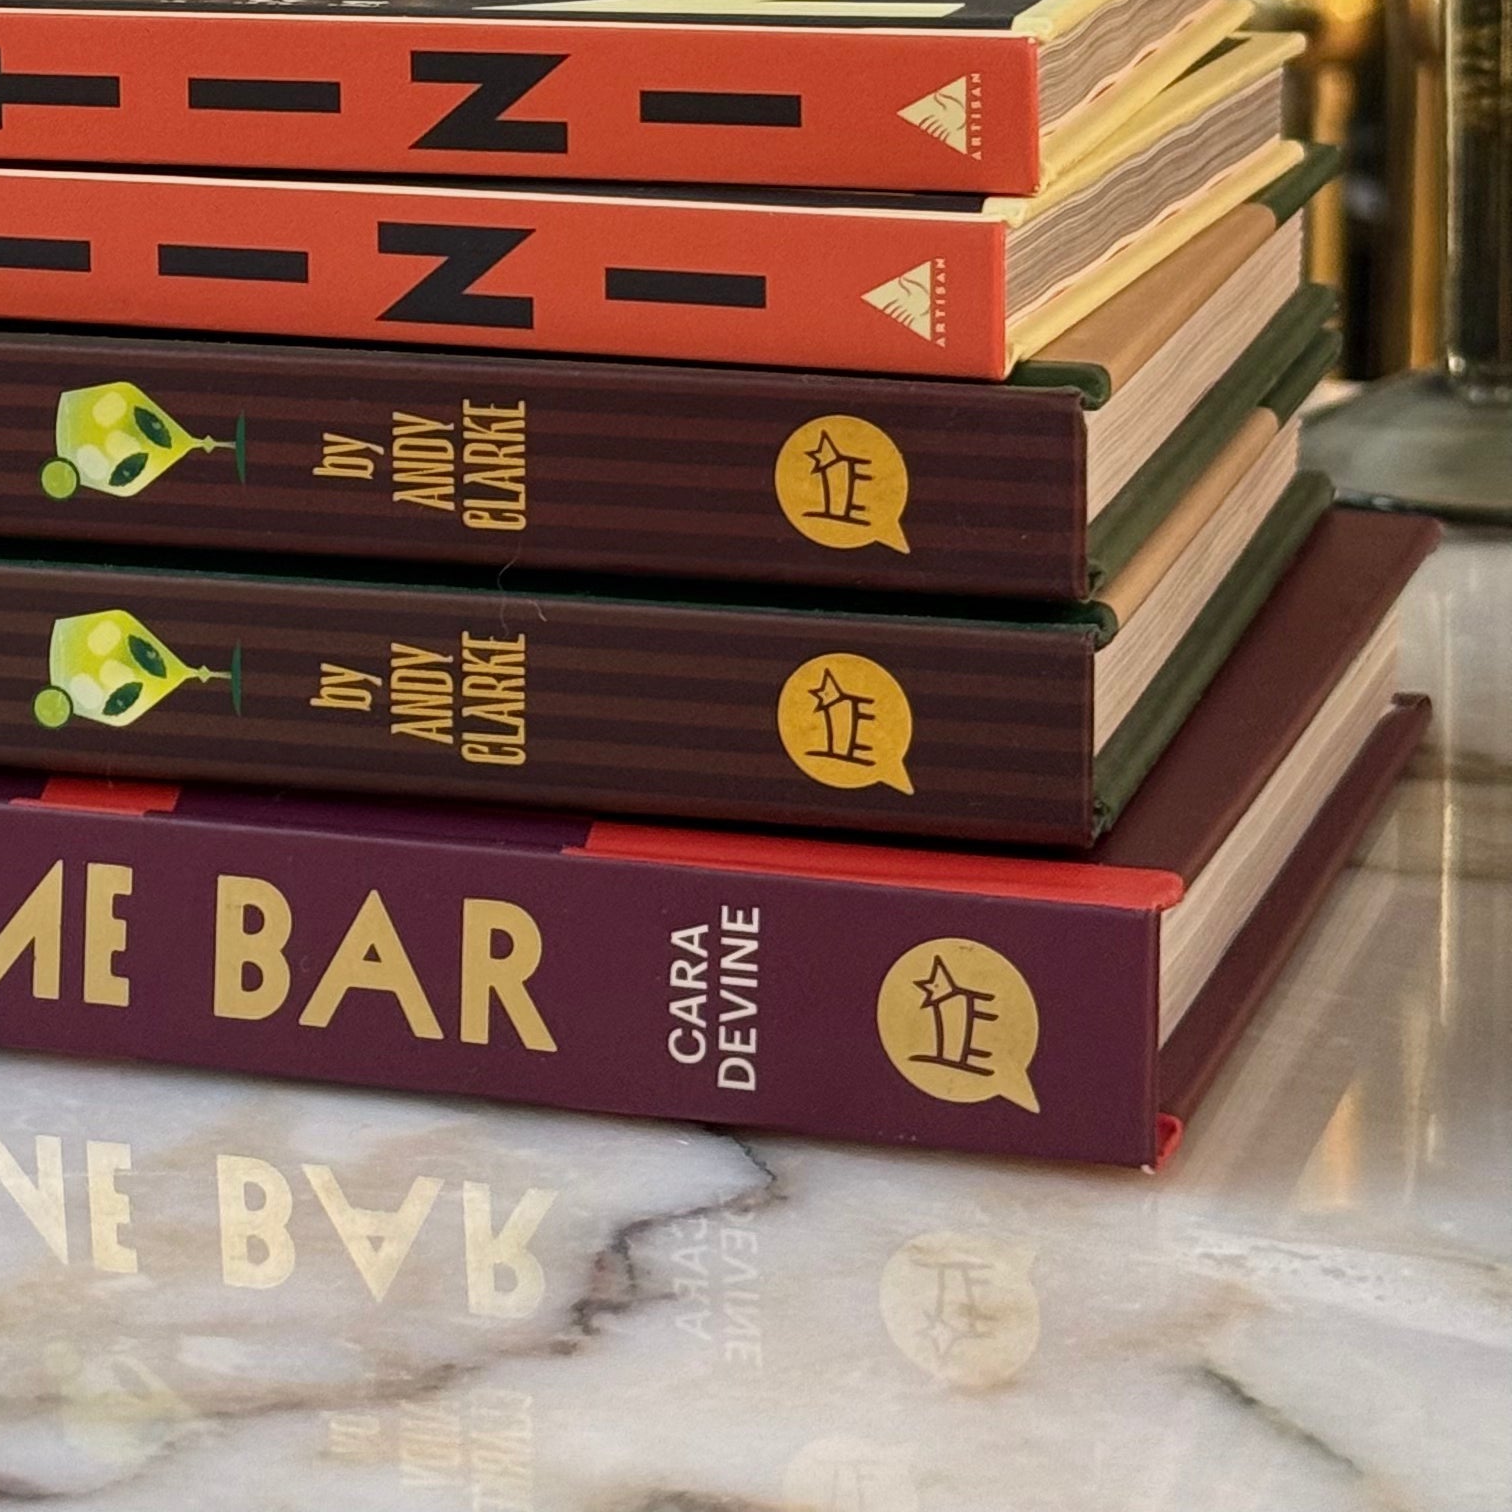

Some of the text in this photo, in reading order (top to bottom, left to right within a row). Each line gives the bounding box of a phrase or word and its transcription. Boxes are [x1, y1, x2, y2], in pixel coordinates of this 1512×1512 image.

[971, 73, 982, 161] ARTISAN
[935, 258, 946, 348] ARTISAN
[312, 432, 385, 480] by
[392, 411, 455, 511] ANDY
[462, 398, 526, 531] CLARKE
[310, 663, 383, 711] by
[390, 642, 453, 744] ANDY
[461, 630, 526, 766] CLARKE
[213, 874, 558, 1053] BAR
[668, 923, 710, 1064] CARA
[716, 904, 761, 1092] DEVINE
